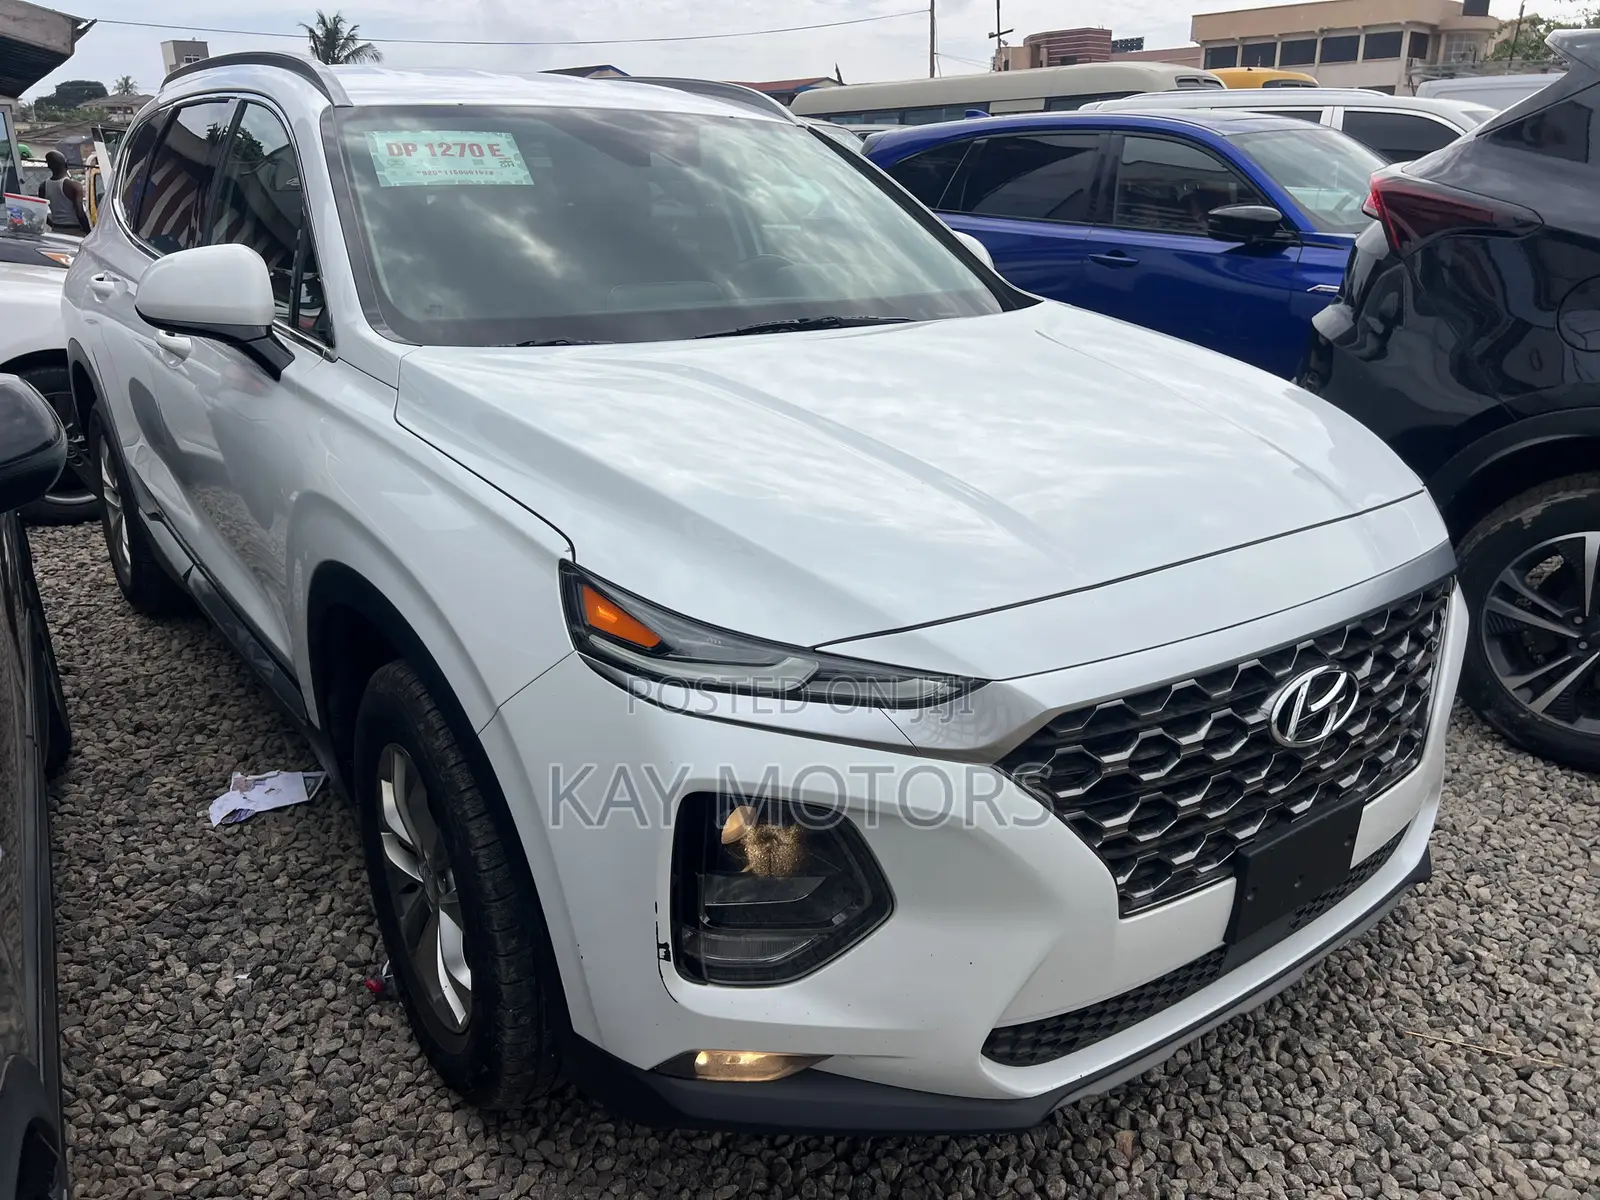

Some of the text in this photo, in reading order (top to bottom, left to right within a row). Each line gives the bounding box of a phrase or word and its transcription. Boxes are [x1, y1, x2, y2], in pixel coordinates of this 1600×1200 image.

[386, 142, 505, 157] DP 1270 E
